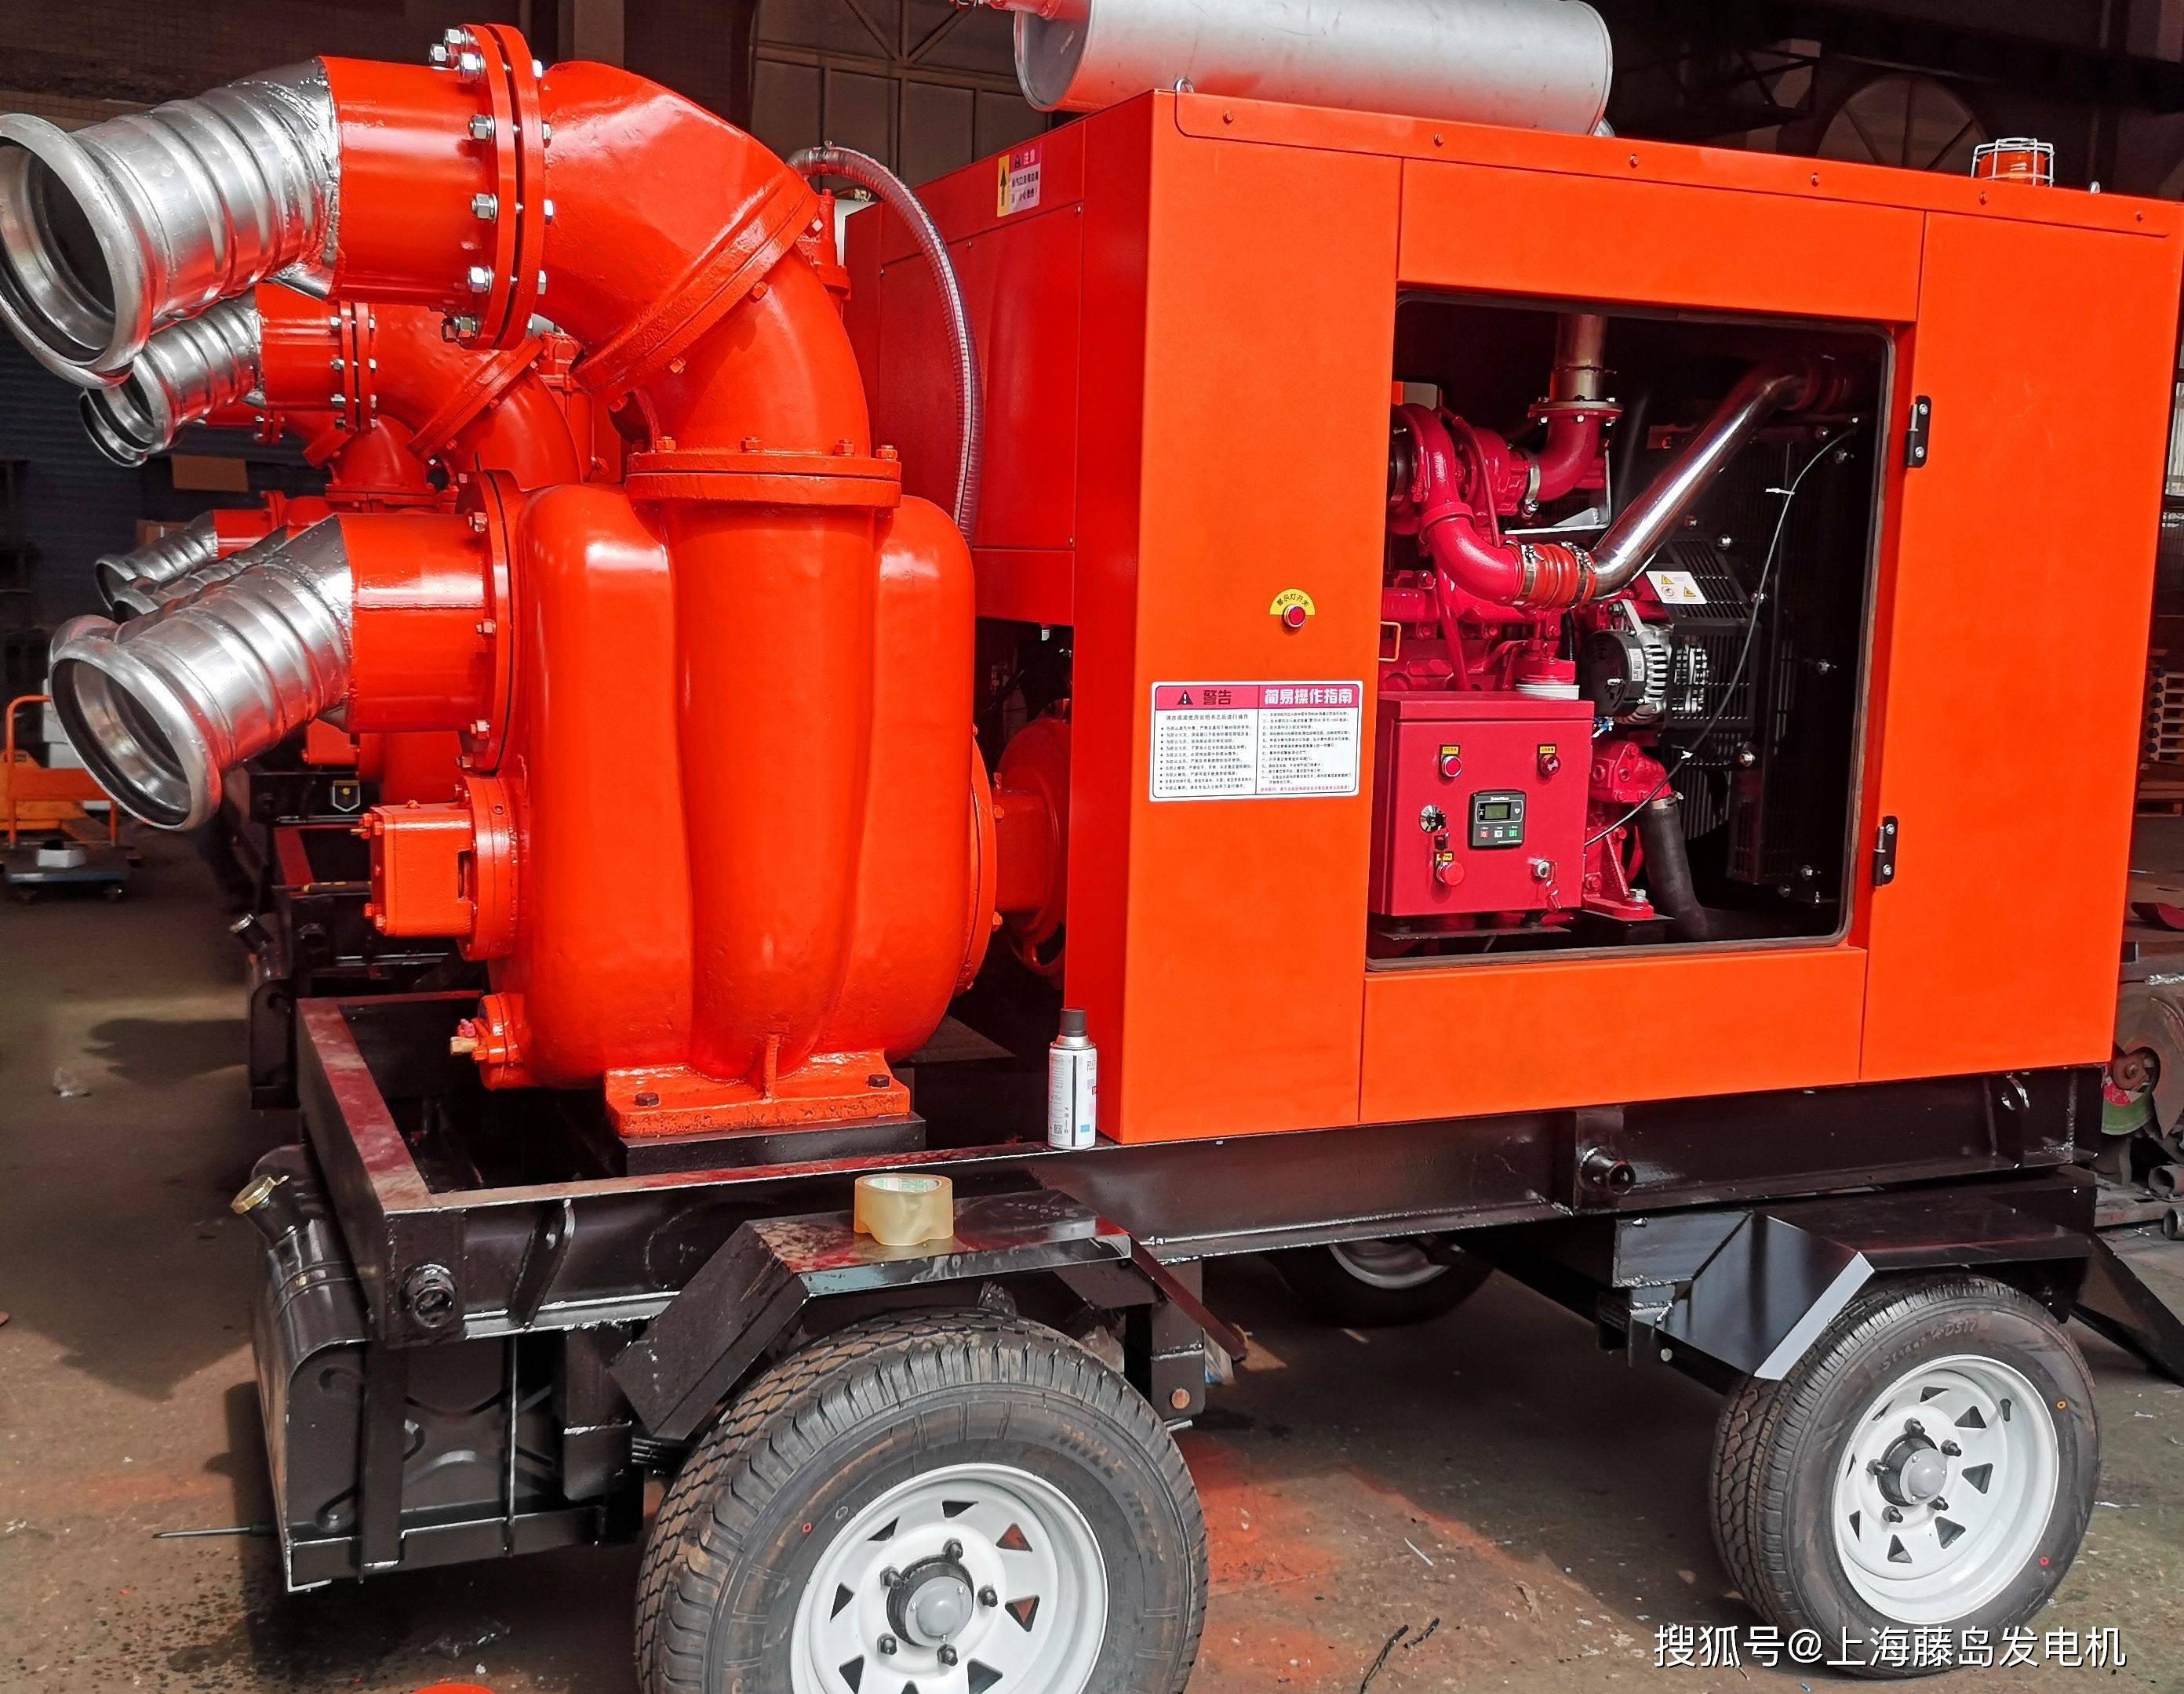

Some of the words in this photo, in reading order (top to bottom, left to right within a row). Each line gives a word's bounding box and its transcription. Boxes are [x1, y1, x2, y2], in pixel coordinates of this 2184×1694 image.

[1203, 689, 1232, 705] 警告
[1264, 688, 1353, 705] 简易操作指南
